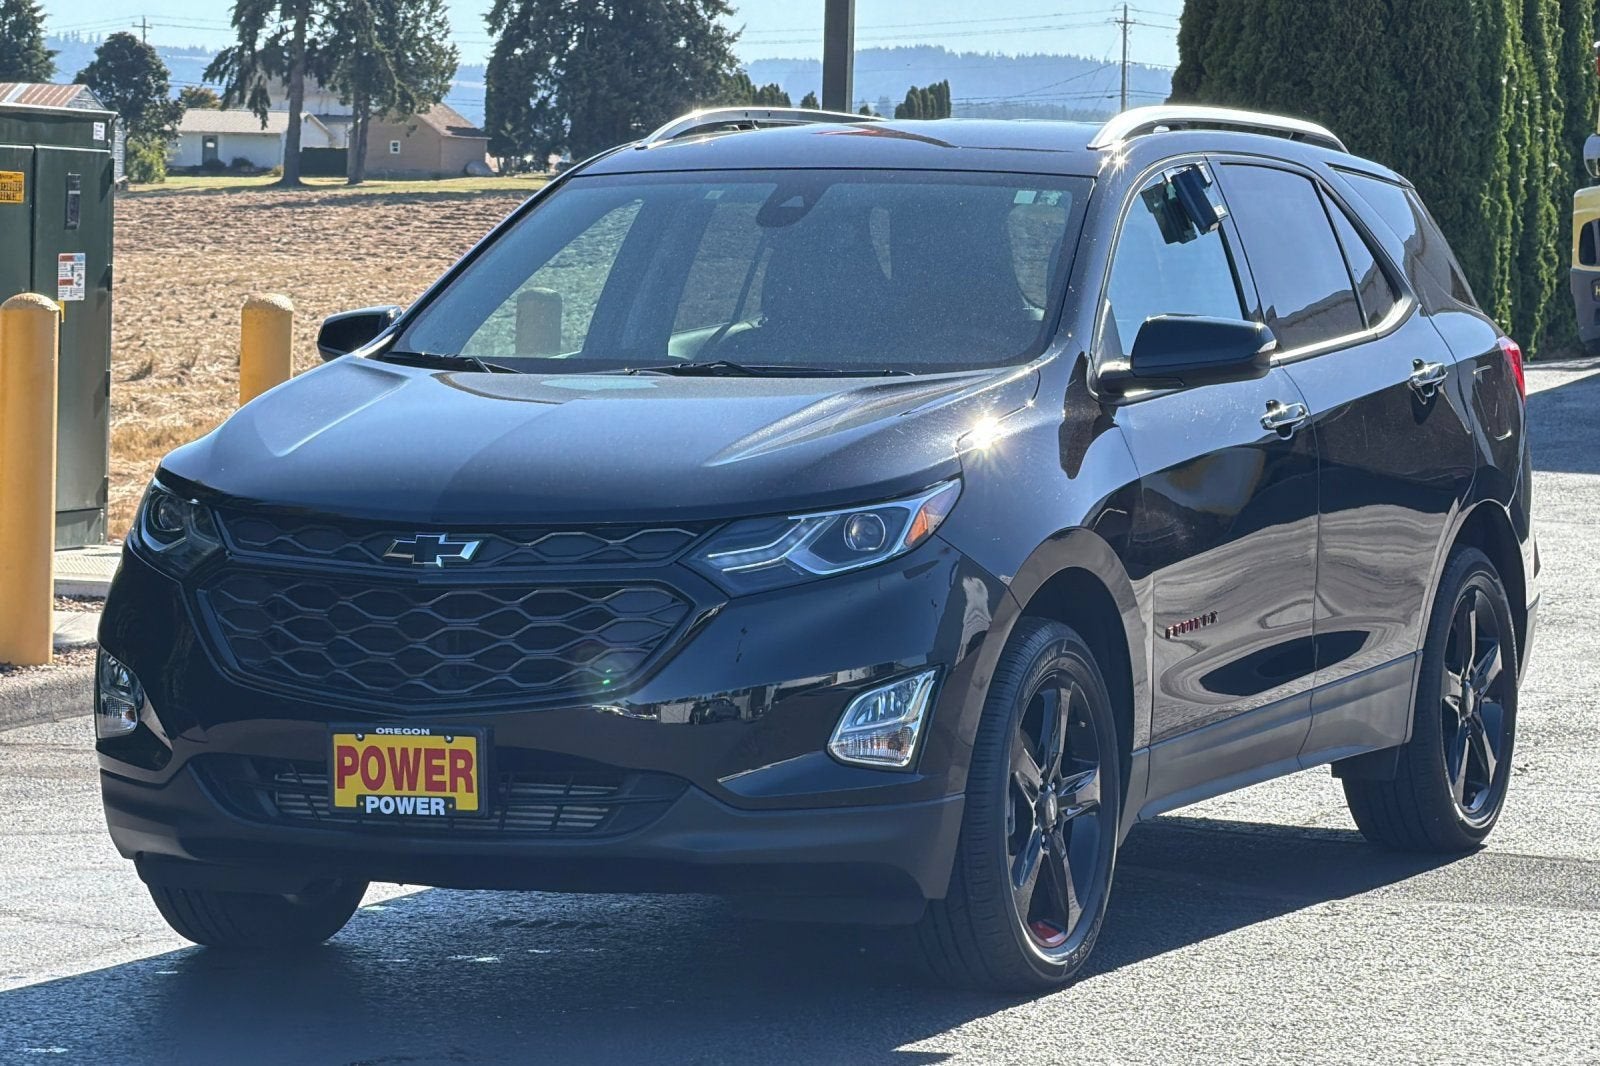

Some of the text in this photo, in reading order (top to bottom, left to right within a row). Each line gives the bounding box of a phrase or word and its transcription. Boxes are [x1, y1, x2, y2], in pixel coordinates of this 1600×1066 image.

[376, 727, 430, 735] OREGON
[336, 745, 474, 793] POWER
[365, 796, 446, 816] POWER
